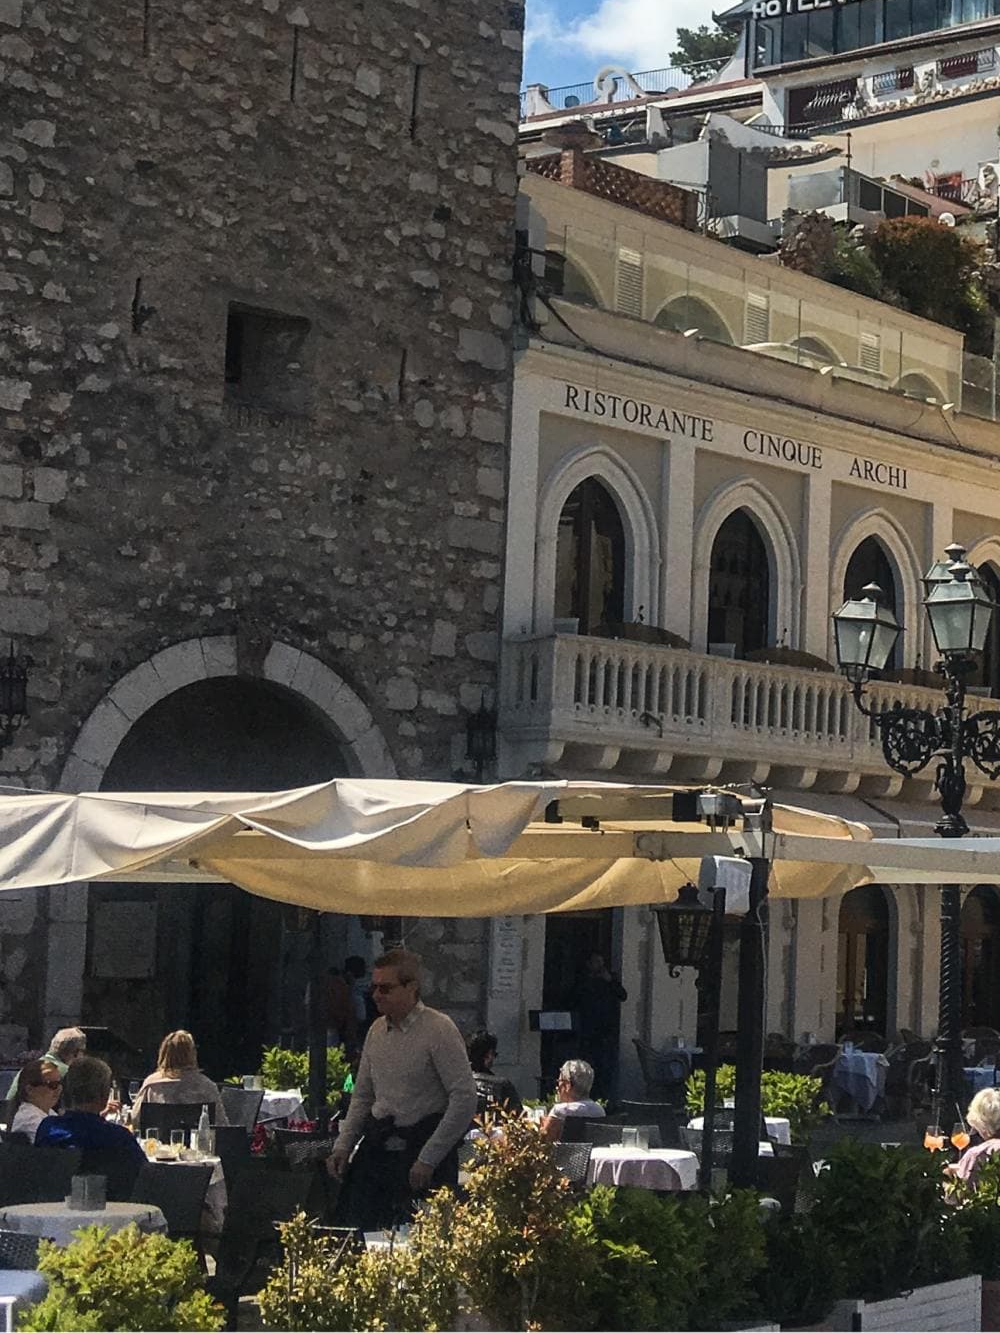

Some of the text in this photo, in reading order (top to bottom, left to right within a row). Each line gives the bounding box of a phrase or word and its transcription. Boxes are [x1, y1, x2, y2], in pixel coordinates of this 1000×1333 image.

[565, 384, 908, 490] RISTORANTE CINQUE ARCHI
